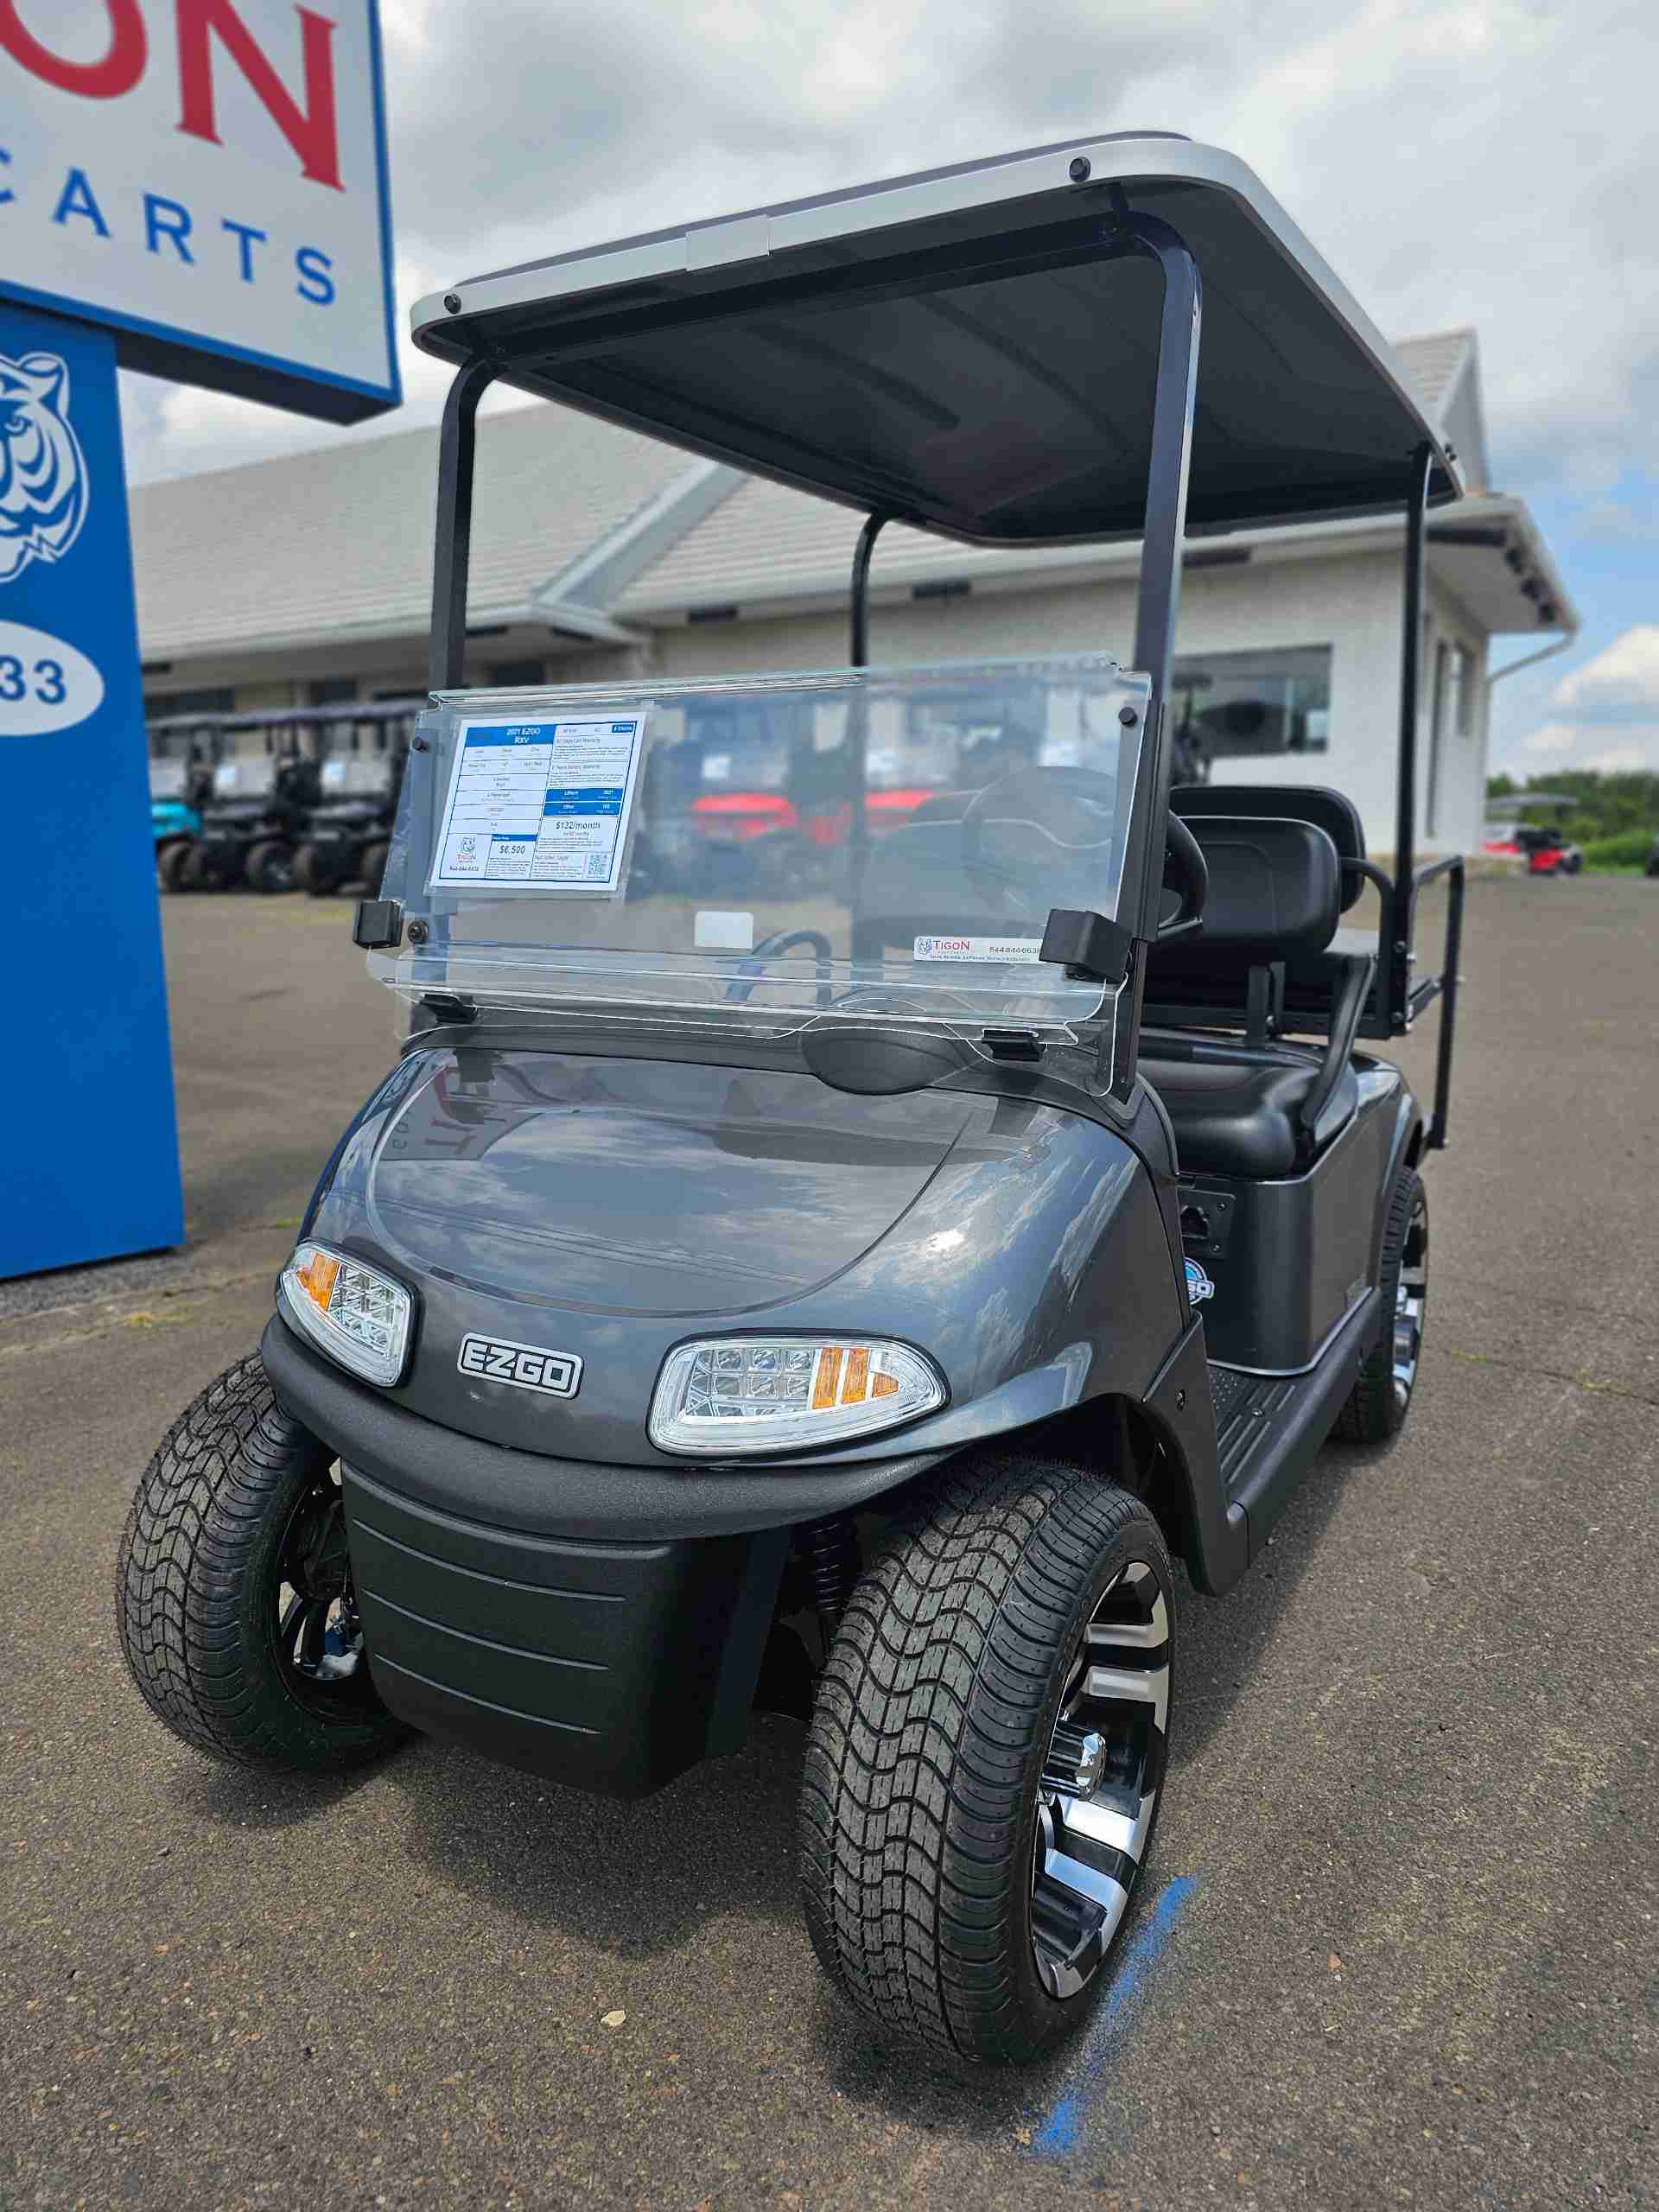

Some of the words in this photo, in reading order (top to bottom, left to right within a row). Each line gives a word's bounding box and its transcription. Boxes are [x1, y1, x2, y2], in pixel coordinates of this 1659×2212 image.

[556, 821, 601, 830] $132/month
[499, 844, 525, 855] $6,500
[463, 1341, 573, 1389] EZGO
